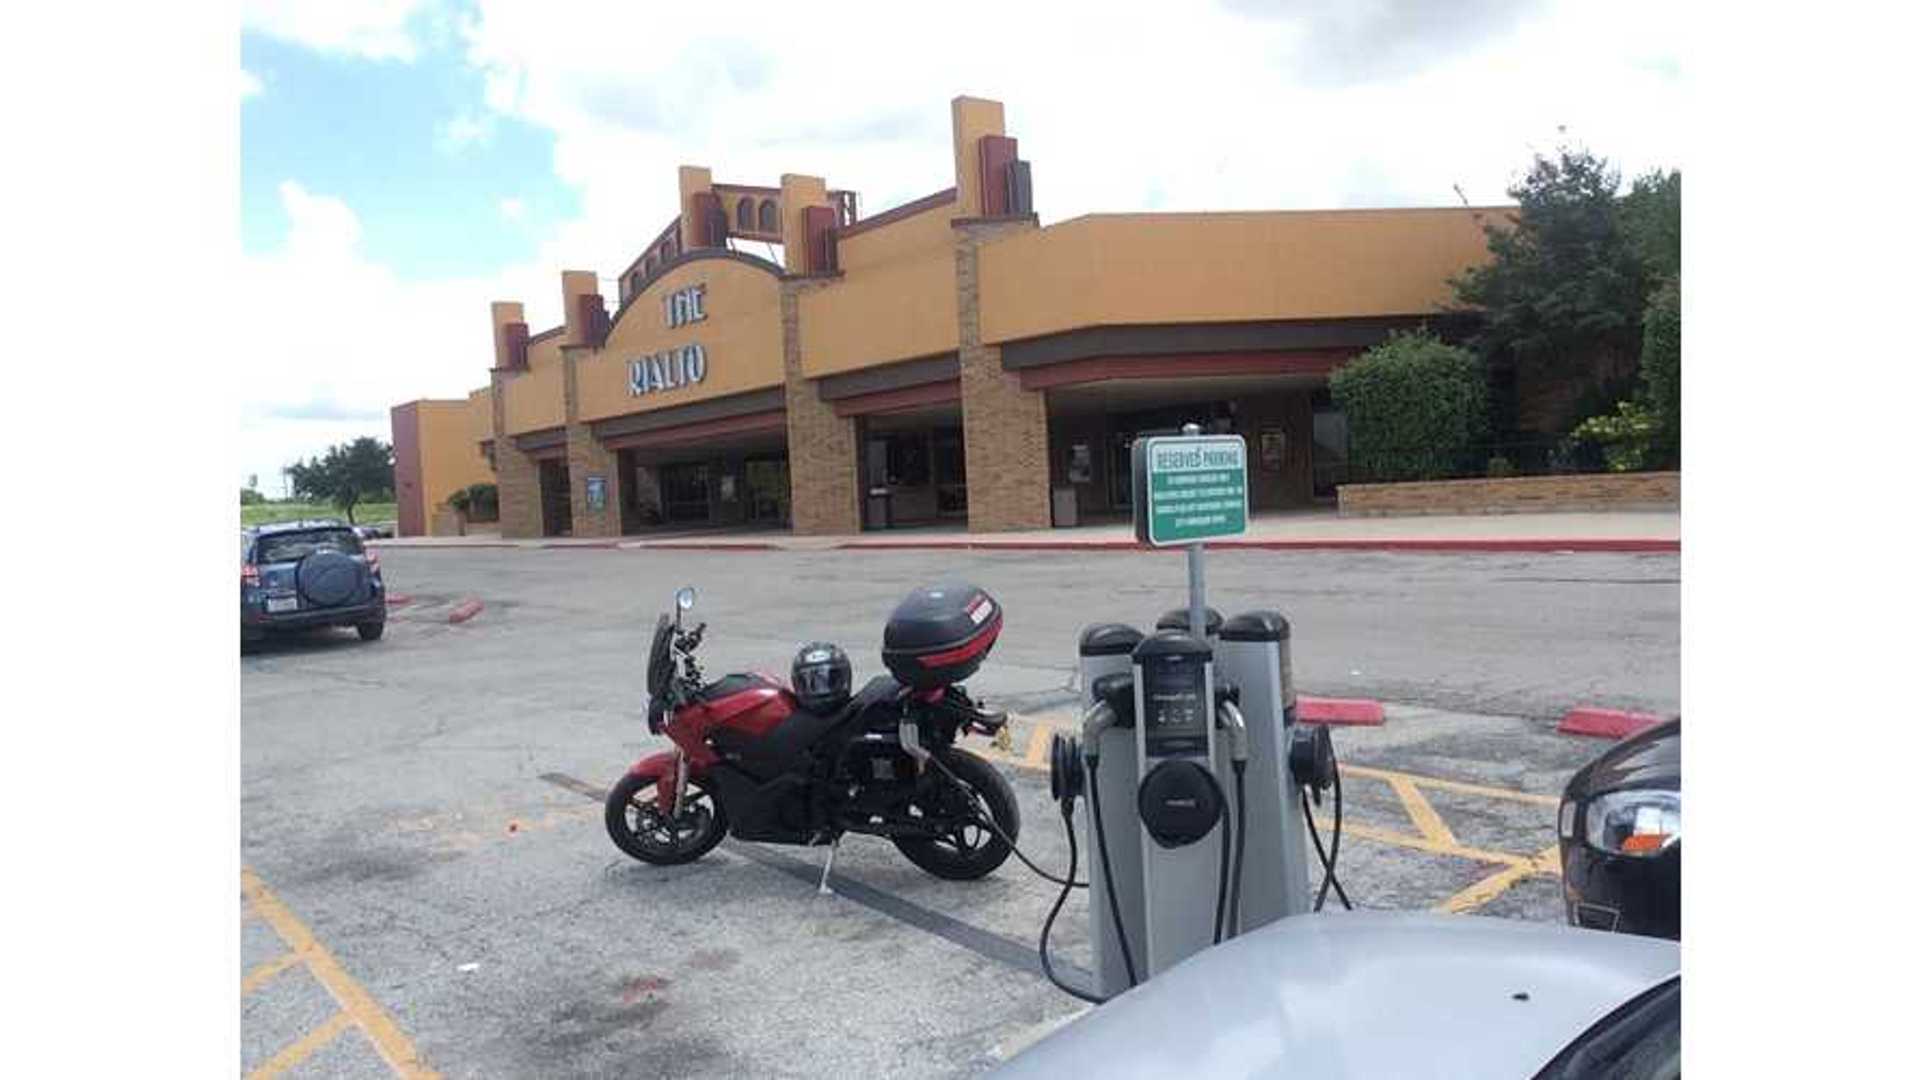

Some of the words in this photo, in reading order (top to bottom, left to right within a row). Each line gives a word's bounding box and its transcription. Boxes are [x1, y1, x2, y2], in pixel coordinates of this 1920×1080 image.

[662, 286, 708, 328] THE
[625, 345, 708, 397] RIALTO
[1157, 450, 1201, 468] RESERVED
[1203, 449, 1240, 467] PARKING
